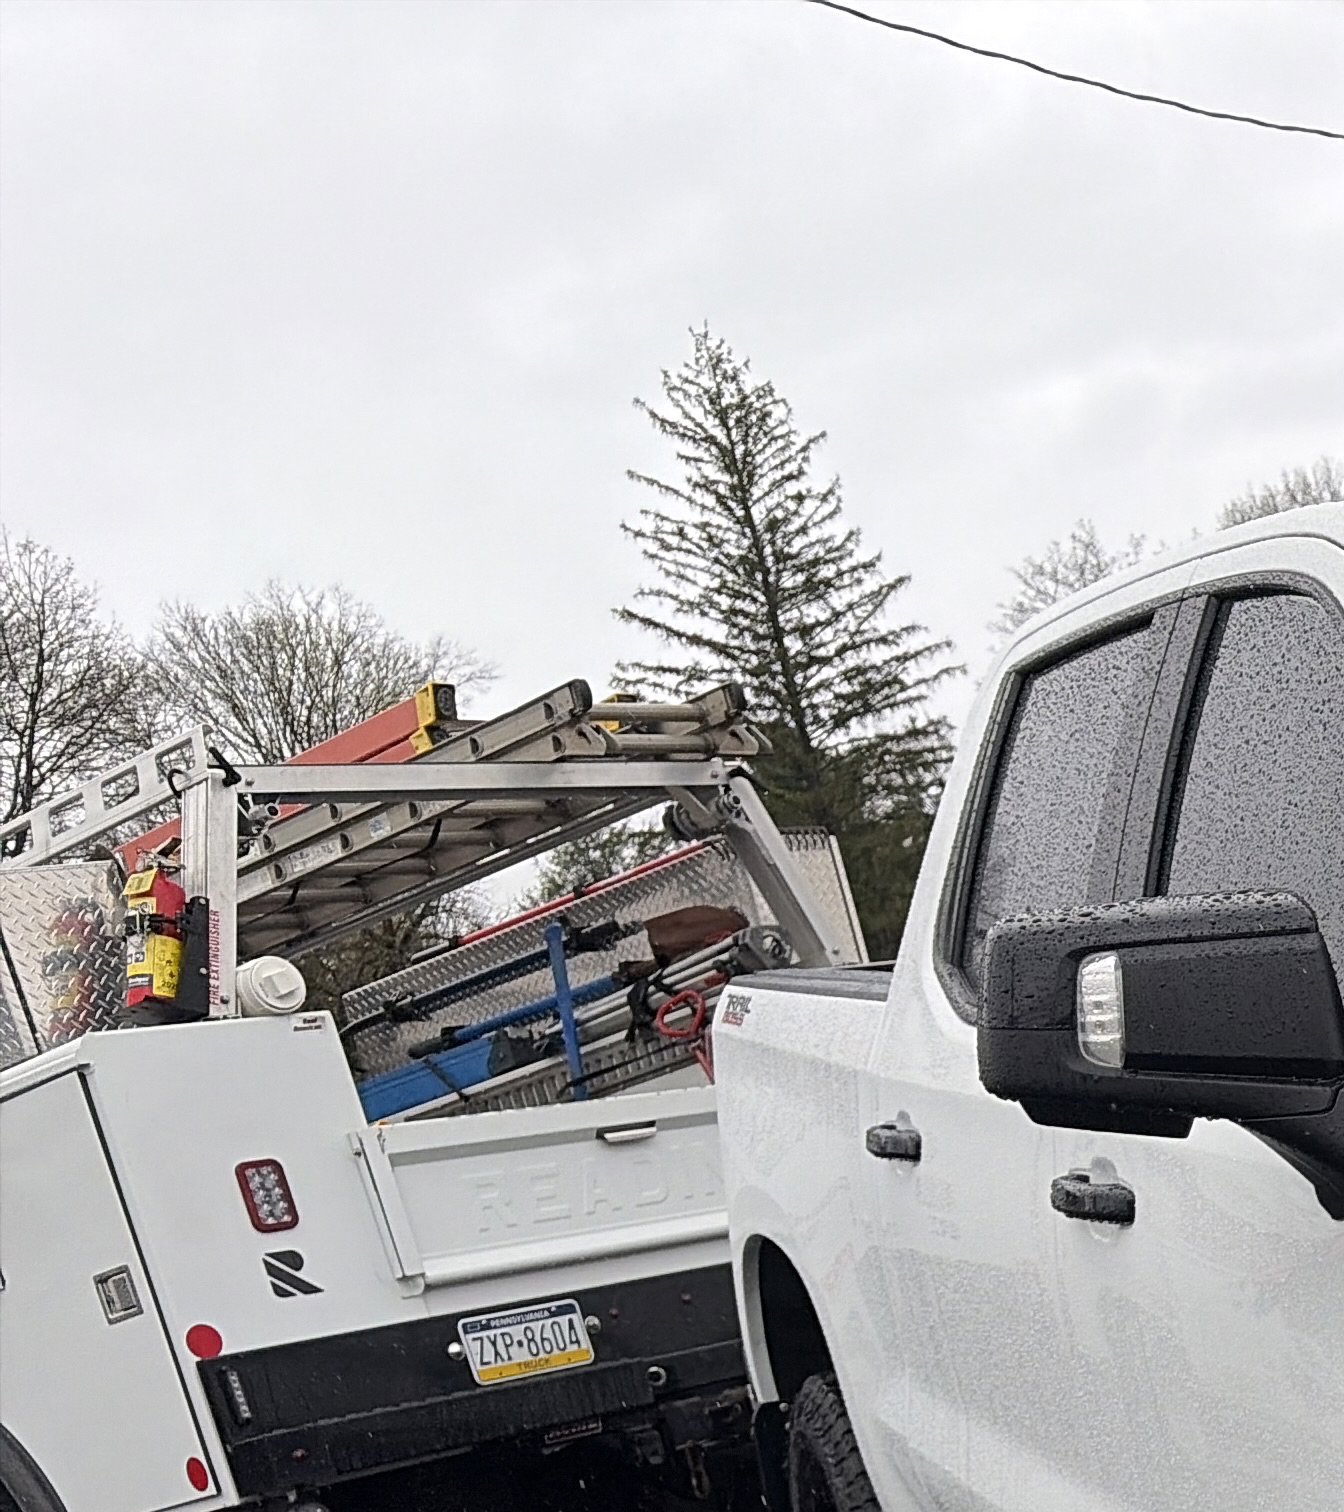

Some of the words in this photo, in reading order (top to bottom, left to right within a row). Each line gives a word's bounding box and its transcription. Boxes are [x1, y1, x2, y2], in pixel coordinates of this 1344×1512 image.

[209, 909, 221, 981] EXTINGUISHER
[209, 982, 221, 1006] FIRE
[490, 1309, 550, 1328] PENNSYLVANIA
[517, 1357, 551, 1371] TRUCK
